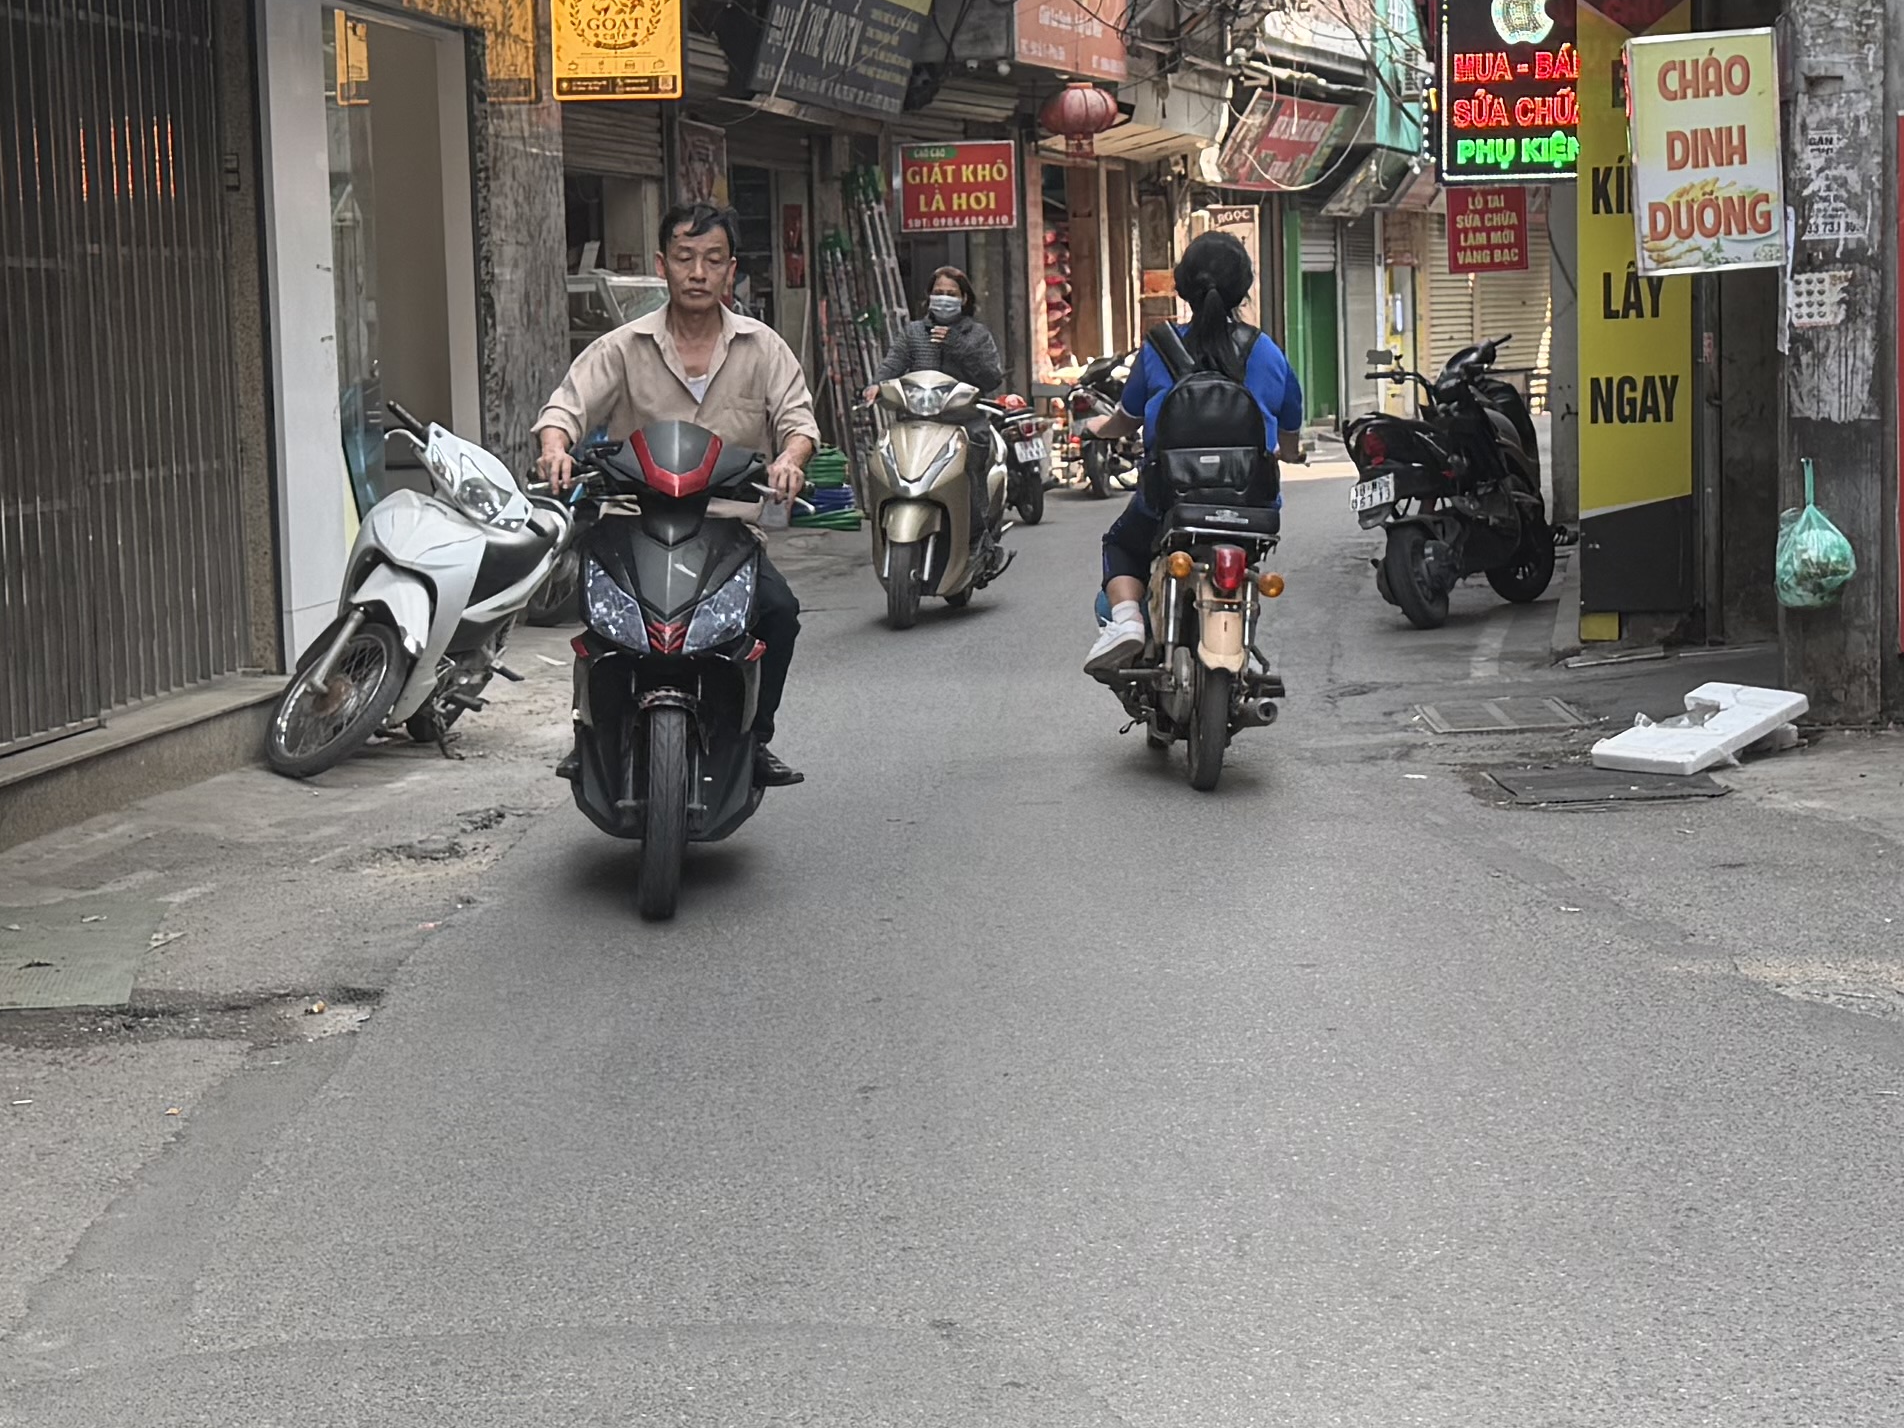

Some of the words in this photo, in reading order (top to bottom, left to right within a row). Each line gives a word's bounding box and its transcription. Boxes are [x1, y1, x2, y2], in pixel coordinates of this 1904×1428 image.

[587, 17, 643, 31] GOAT
[1453, 52, 1513, 83] MUA
[1656, 46, 1751, 103] CHÁO
[1453, 88, 1509, 128] SỬA
[1515, 86, 1580, 127] CHỮ
[1457, 138, 1515, 170] PHỤ
[1665, 124, 1748, 172] DINH
[907, 163, 956, 188] GIẶT
[961, 159, 1008, 183] KHÔ
[919, 189, 946, 212] LÀ
[952, 191, 996, 210] HƠI
[1647, 185, 1773, 242] DƯỠNG
[1456, 210, 1481, 229] SỬA
[1484, 209, 1518, 227] CHỮA
[1460, 229, 1486, 246] LÀM
[1490, 228, 1514, 244] MỚI
[1457, 248, 1490, 265] VÀNG
[1494, 248, 1519, 265] BẠC
[1589, 374, 1679, 425] NGAY
